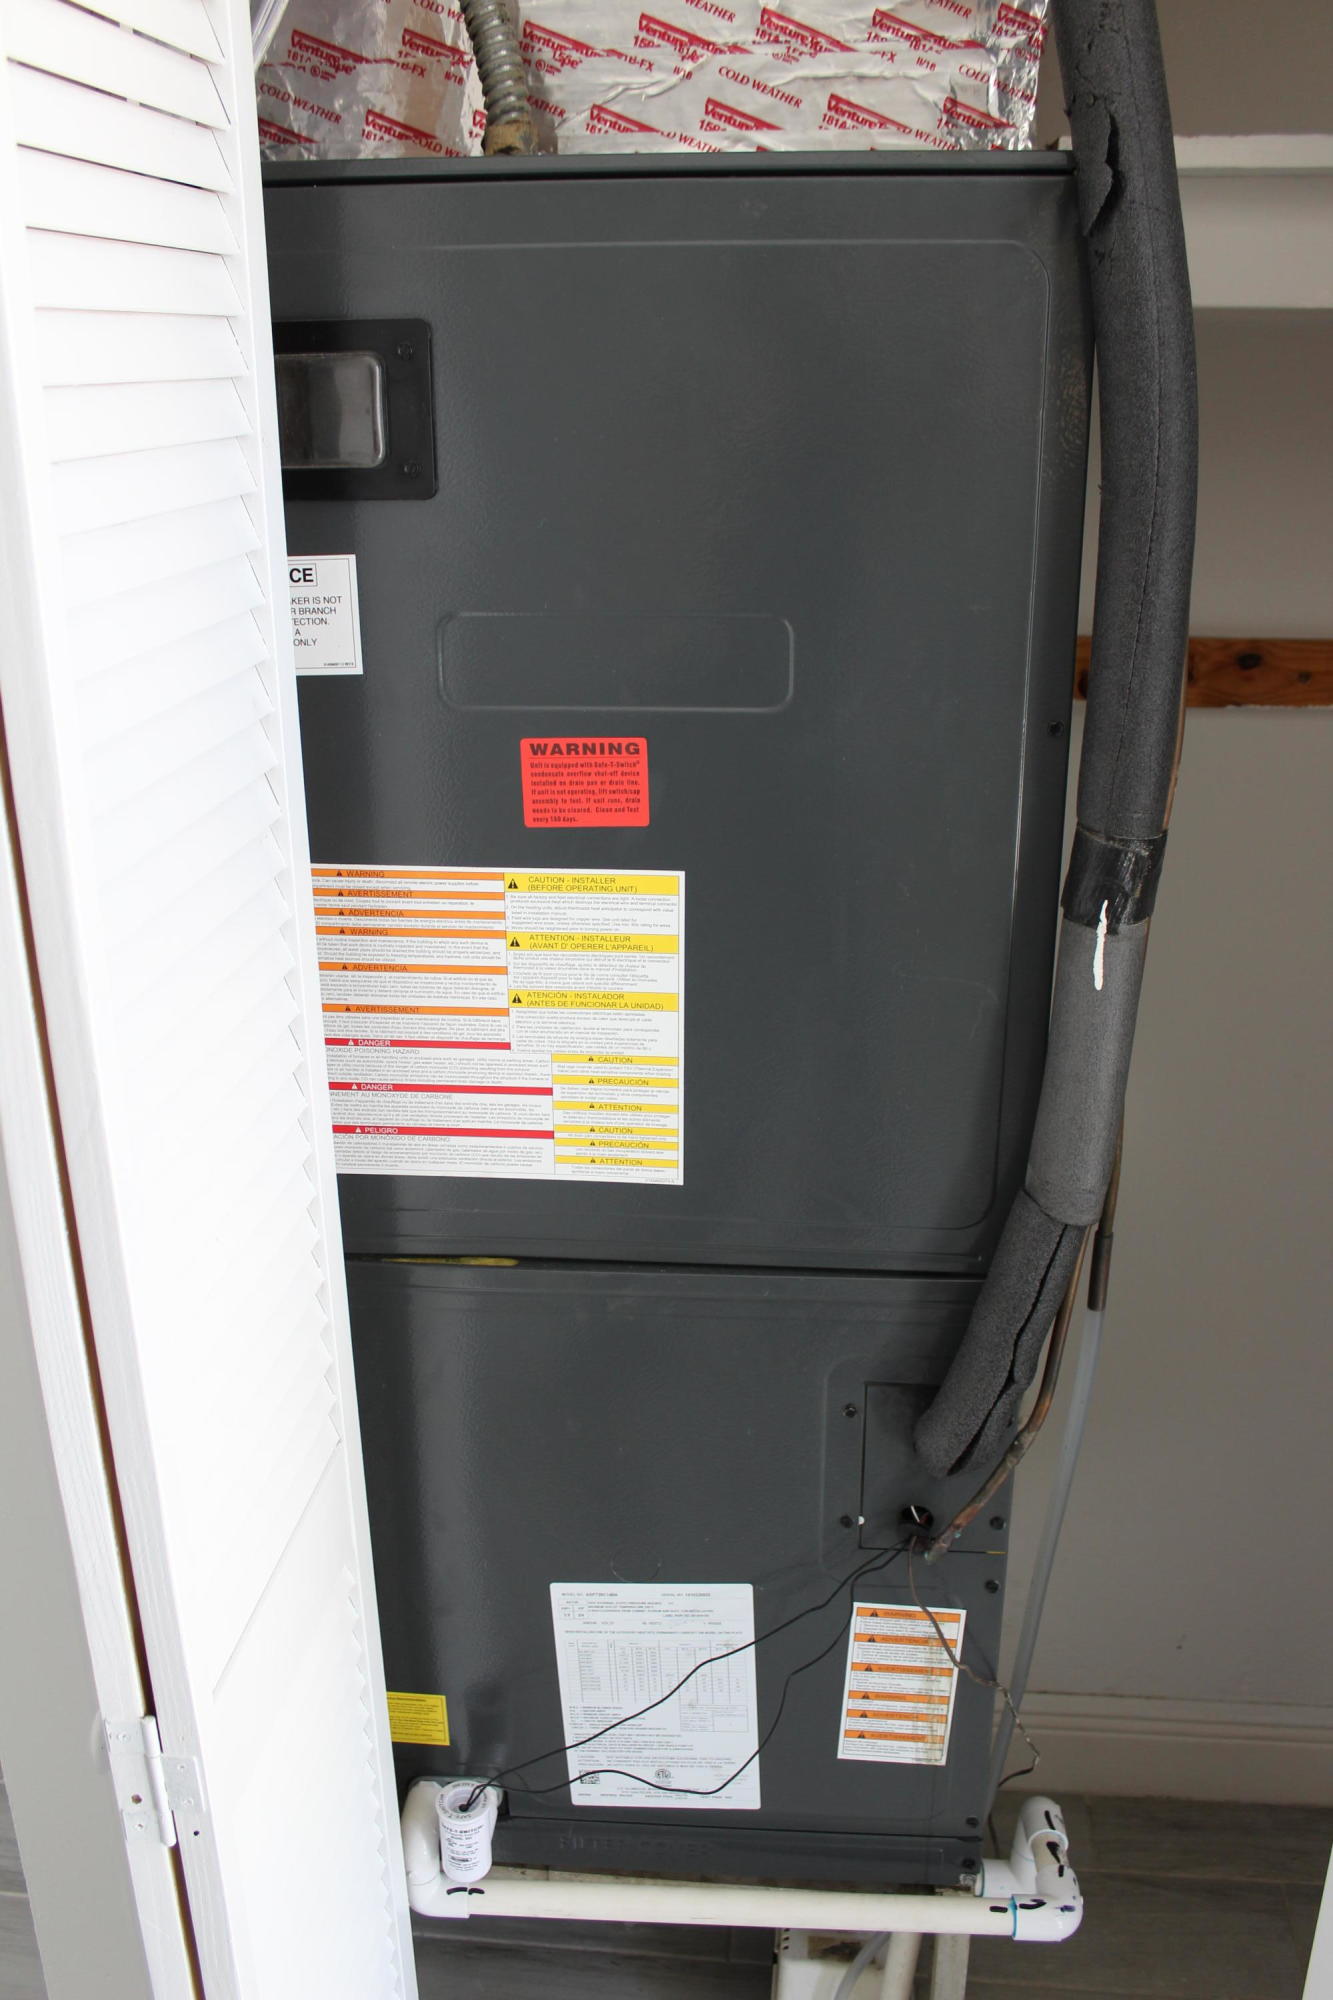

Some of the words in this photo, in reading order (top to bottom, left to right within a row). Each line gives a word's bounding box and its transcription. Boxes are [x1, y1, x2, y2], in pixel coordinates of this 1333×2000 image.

[718, 65, 751, 86] COLD
[752, 78, 803, 108] WEATHER
[259, 82, 293, 102] COLD
[293, 96, 343, 125] WEATHER
[312, 596, 321, 605] IS
[323, 596, 342, 604] NOT
[299, 606, 337, 616] BRANCH
[293, 638, 318, 647] ONLY
[529, 742, 640, 756] WARNING
[347, 870, 385, 878] WARNING
[528, 876, 565, 884] CAUTION
[571, 876, 616, 885] INSTALLER
[347, 889, 414, 898] AVERTISSEMENT
[566, 885, 614, 893] OPERATING
[615, 885, 638, 894] UNIT)
[348, 908, 405, 917] ADVERTENCIA
[350, 928, 389, 936] WARNING
[581, 935, 631, 943] INSTALLEUR
[352, 964, 408, 972] ADVERTENCIA
[570, 1000, 617, 1008] FUNCIONAR
[358, 1039, 391, 1047] DANGER
[360, 1083, 393, 1091] DANGER
[598, 1103, 642, 1111] ATTENTION
[599, 1158, 643, 1166] ATTENTION
